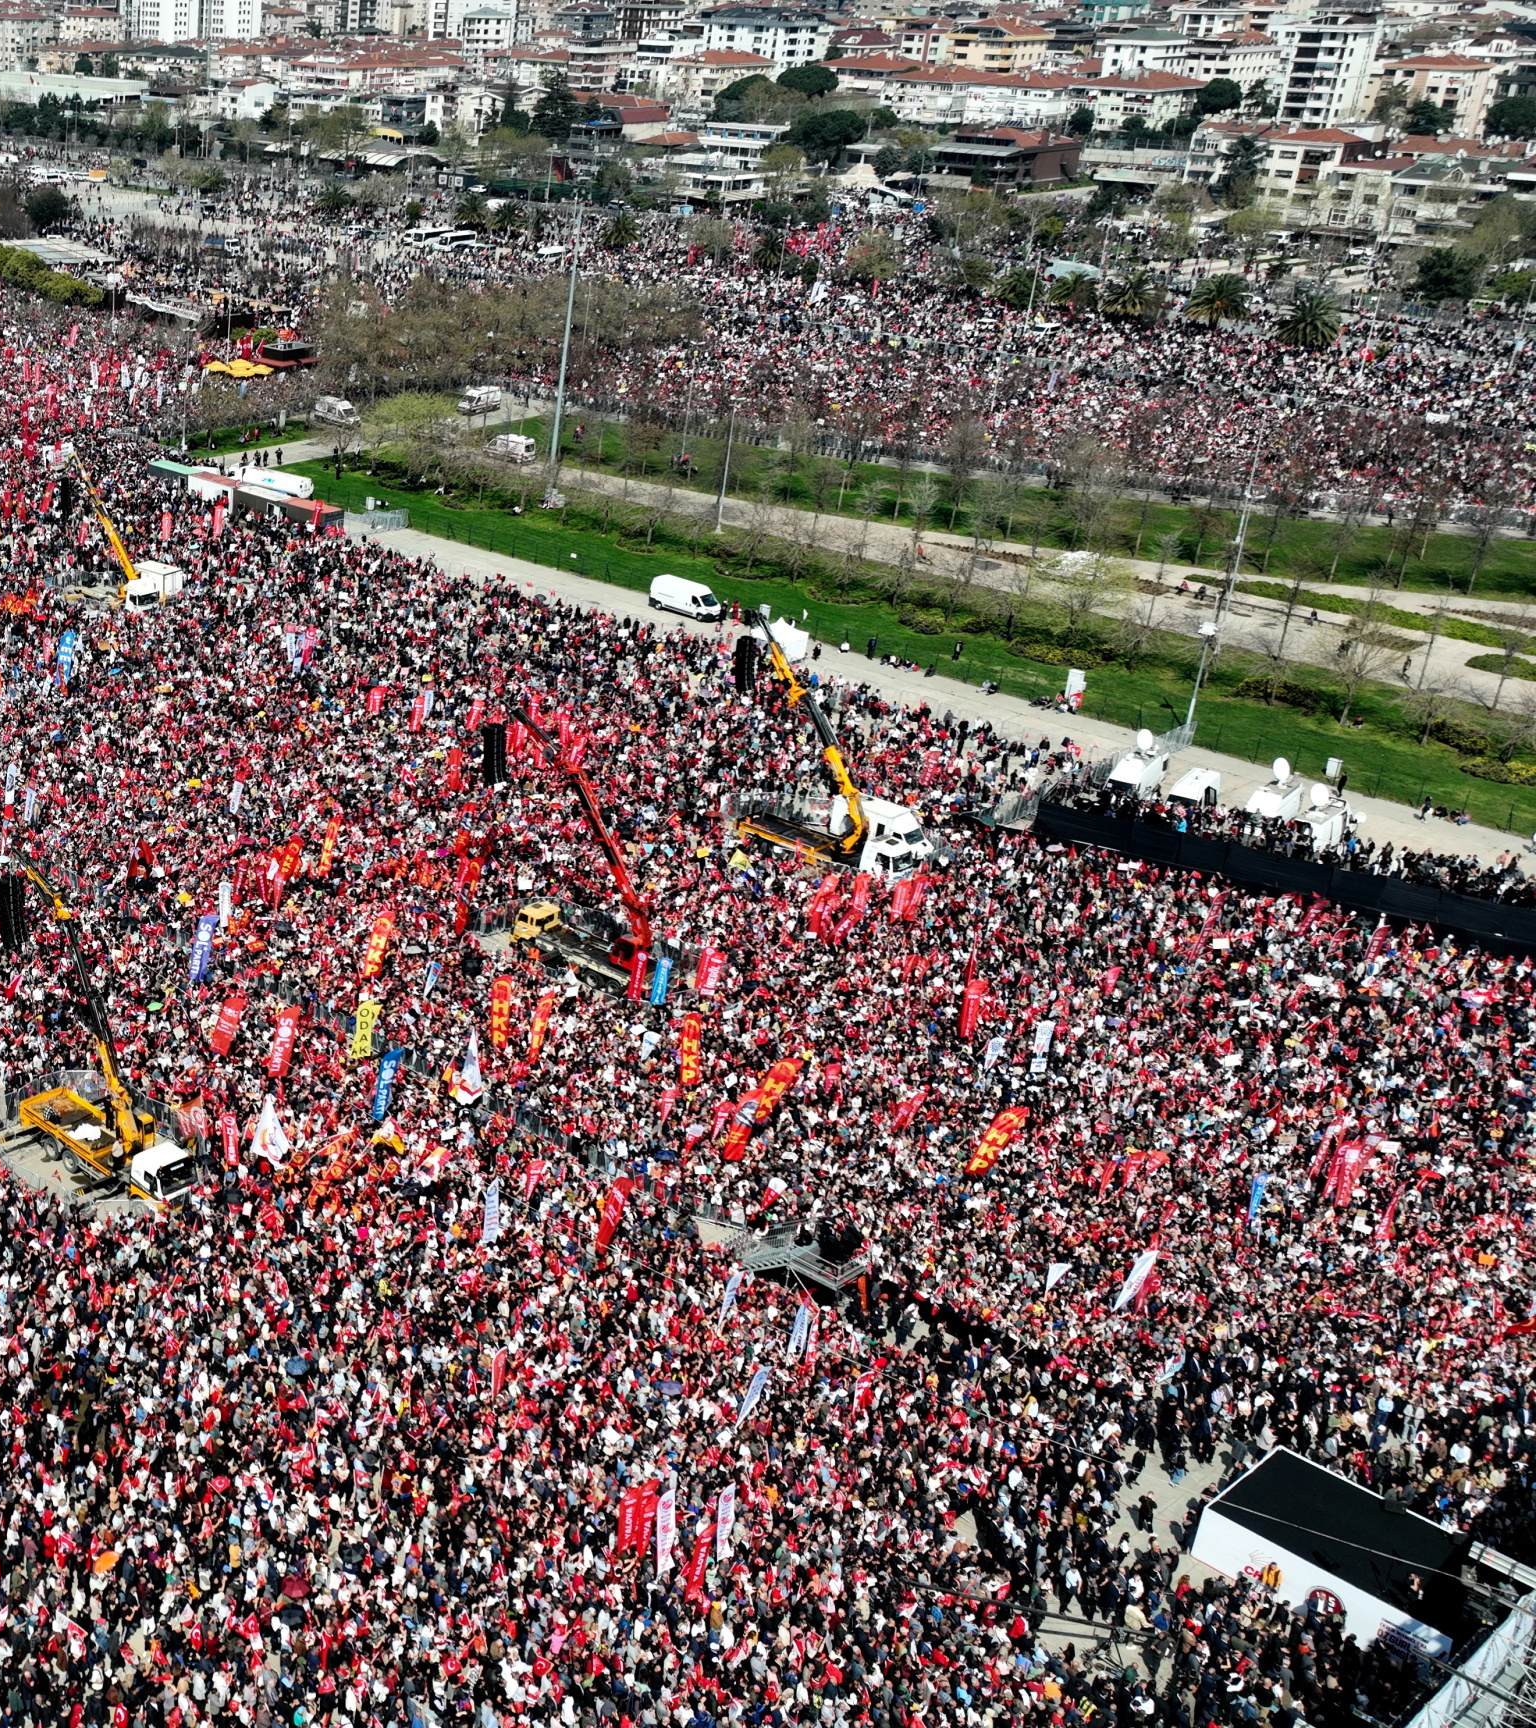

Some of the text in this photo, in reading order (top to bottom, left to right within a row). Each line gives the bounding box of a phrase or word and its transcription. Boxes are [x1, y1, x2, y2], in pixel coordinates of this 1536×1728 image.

[196, 921, 213, 948] SOL
[365, 933, 387, 977] HKP
[276, 1017, 295, 1046] SOL
[359, 1008, 370, 1055] ODAK
[492, 998, 509, 1045] HKP
[378, 1059, 396, 1089] SOL
[682, 1037, 698, 1083] HKP
[755, 1078, 787, 1120] HKP
[969, 1127, 1009, 1172] HKP
[624, 1507, 633, 1540] YALOVA
[693, 1546, 708, 1582] YALOVA
[1243, 1565, 1264, 1581] CH
